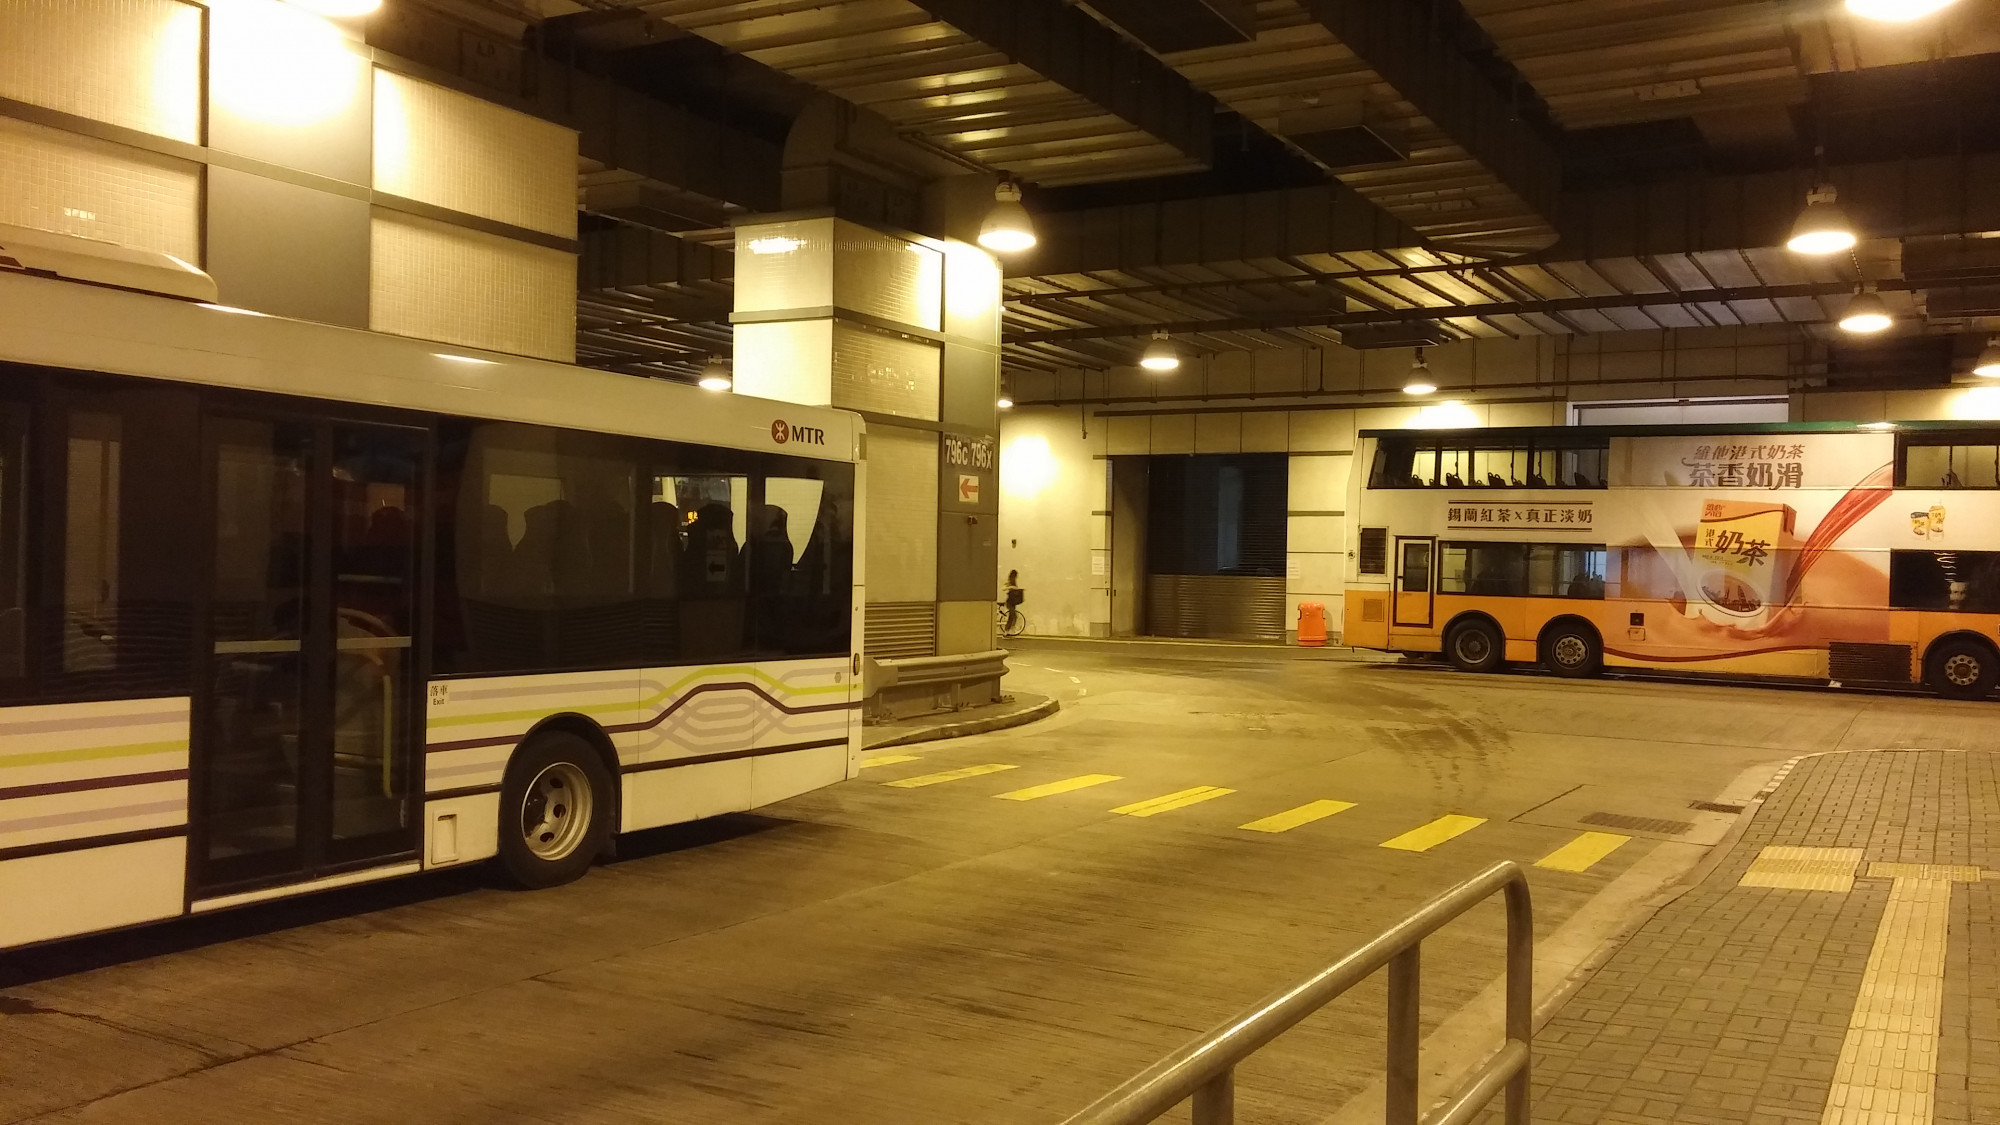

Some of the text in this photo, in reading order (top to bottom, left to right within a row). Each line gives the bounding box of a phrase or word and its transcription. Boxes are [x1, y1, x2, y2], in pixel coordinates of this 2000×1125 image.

[792, 425, 824, 445] MTR
[1694, 444, 1805, 460] 維他港式奶茶
[1682, 458, 1803, 489] 茶香奶滑
[1713, 529, 1770, 566] 奶茶
